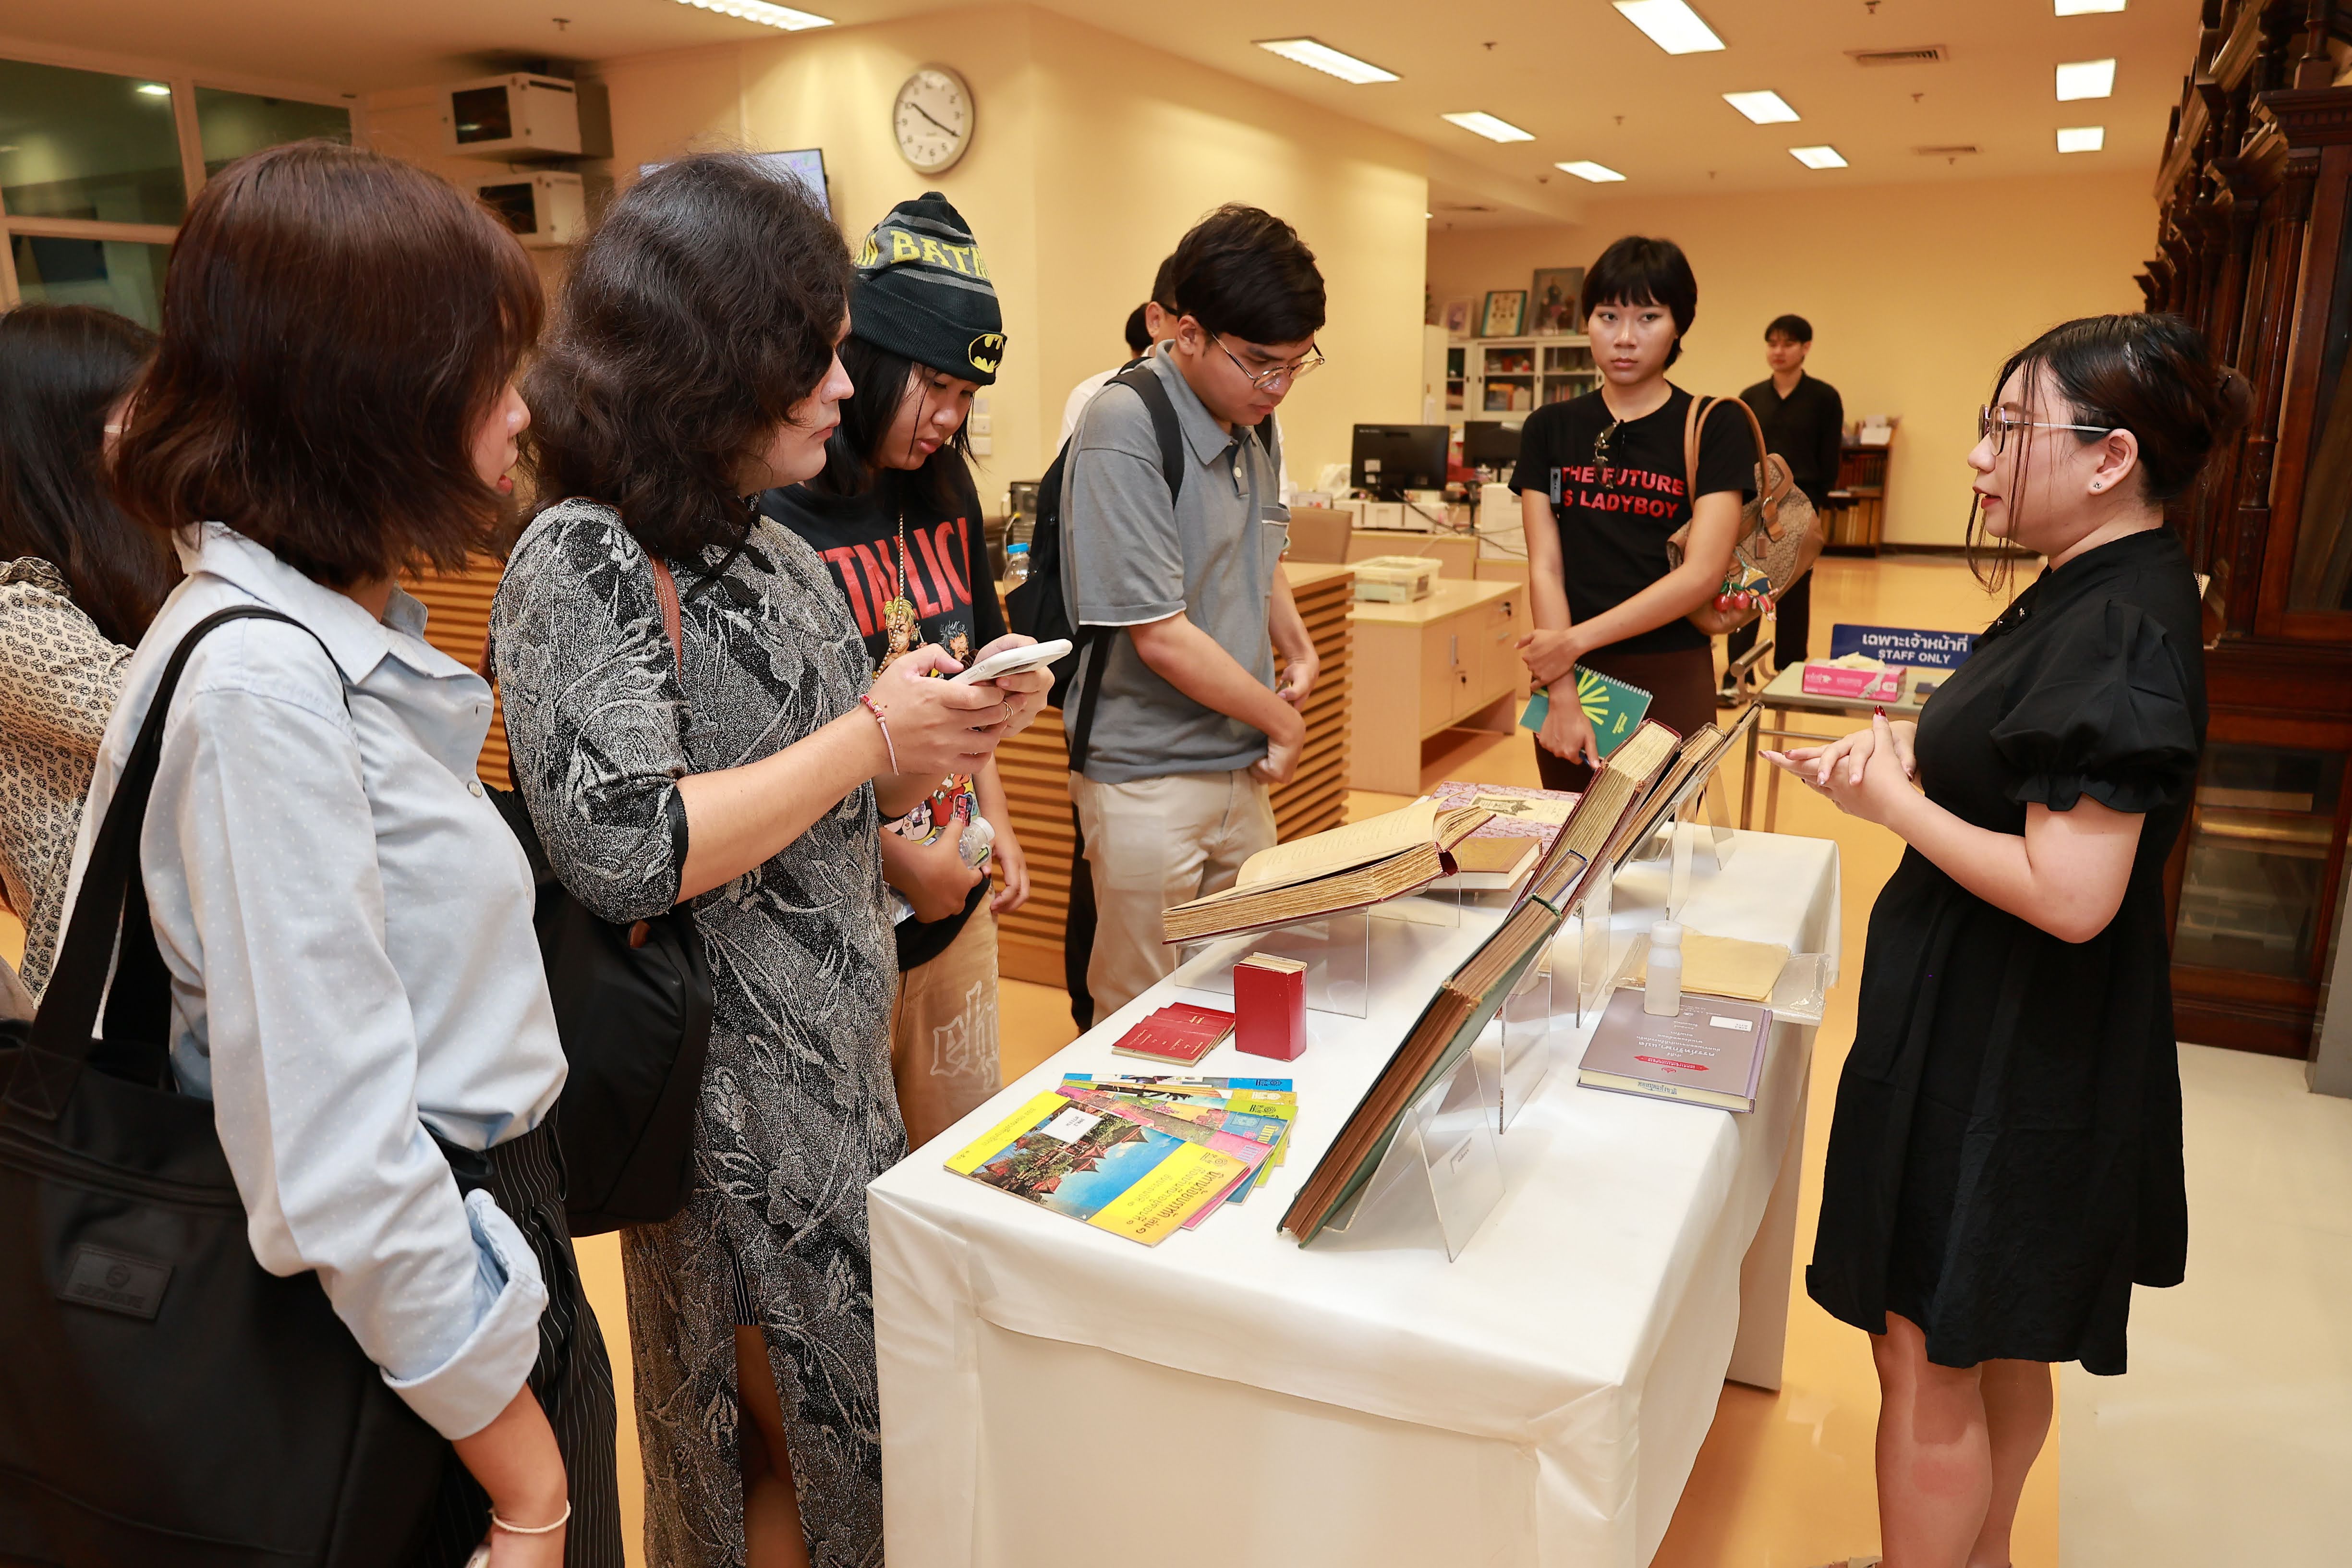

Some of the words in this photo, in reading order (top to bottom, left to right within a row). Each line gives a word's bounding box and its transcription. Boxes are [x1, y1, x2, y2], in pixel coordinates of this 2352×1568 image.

[1602, 469, 1685, 496] FUTURE
[1580, 490, 1679, 519] LADYBOY
[1862, 632, 1969, 652] เฉพาะเจ้าหน้าที่
[1878, 649, 1915, 661] STAFF
[1918, 652, 1951, 664] ONLY
